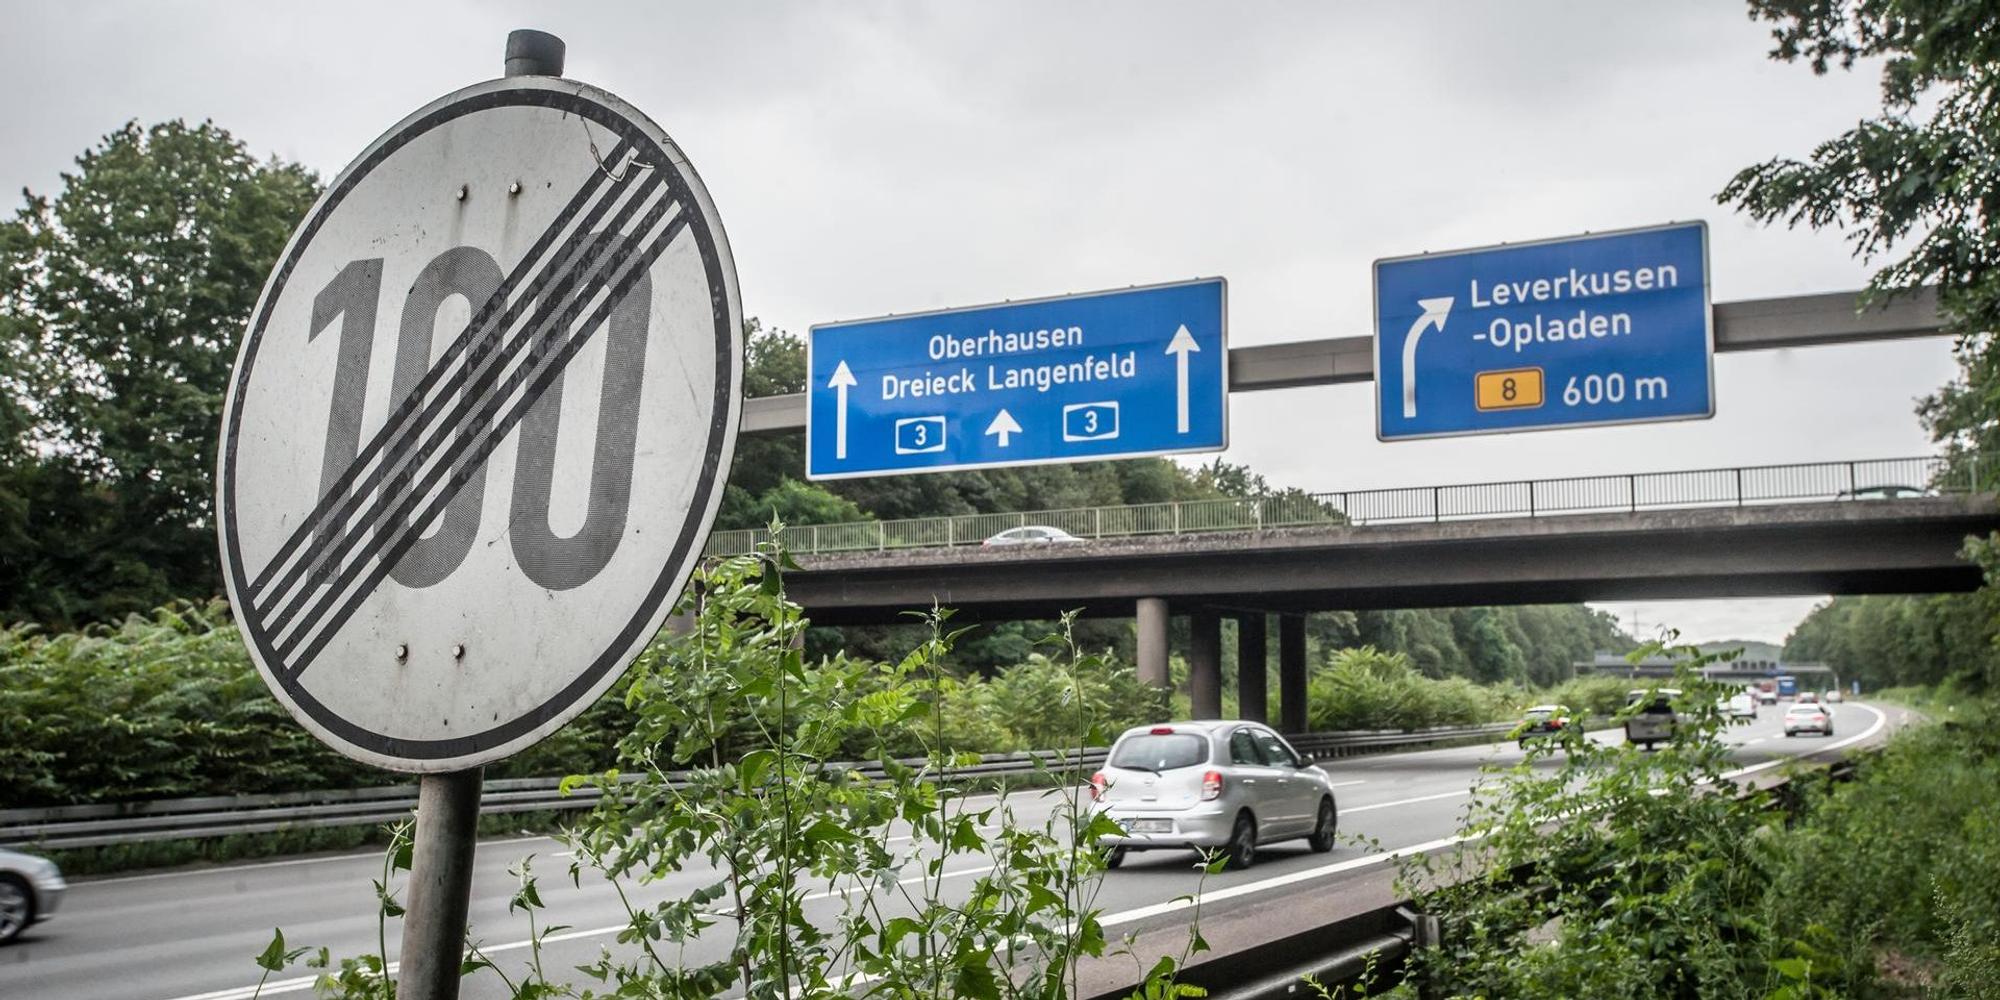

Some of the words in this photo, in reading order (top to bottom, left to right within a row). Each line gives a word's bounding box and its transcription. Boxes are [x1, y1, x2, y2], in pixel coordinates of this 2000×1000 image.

[1471, 265, 1678, 308] Leverkusen
[929, 326, 1083, 360] Oberhausen
[1472, 310, 1631, 352] -Opladen
[882, 368, 976, 400] Dreieck
[988, 351, 1135, 392] Langenfeld
[1502, 377, 1517, 401] 8
[1563, 372, 1625, 406] 600
[1635, 375, 1667, 401] m
[308, 232, 653, 591] 100
[1085, 410, 1098, 433] 3
[915, 424, 927, 446] 3
